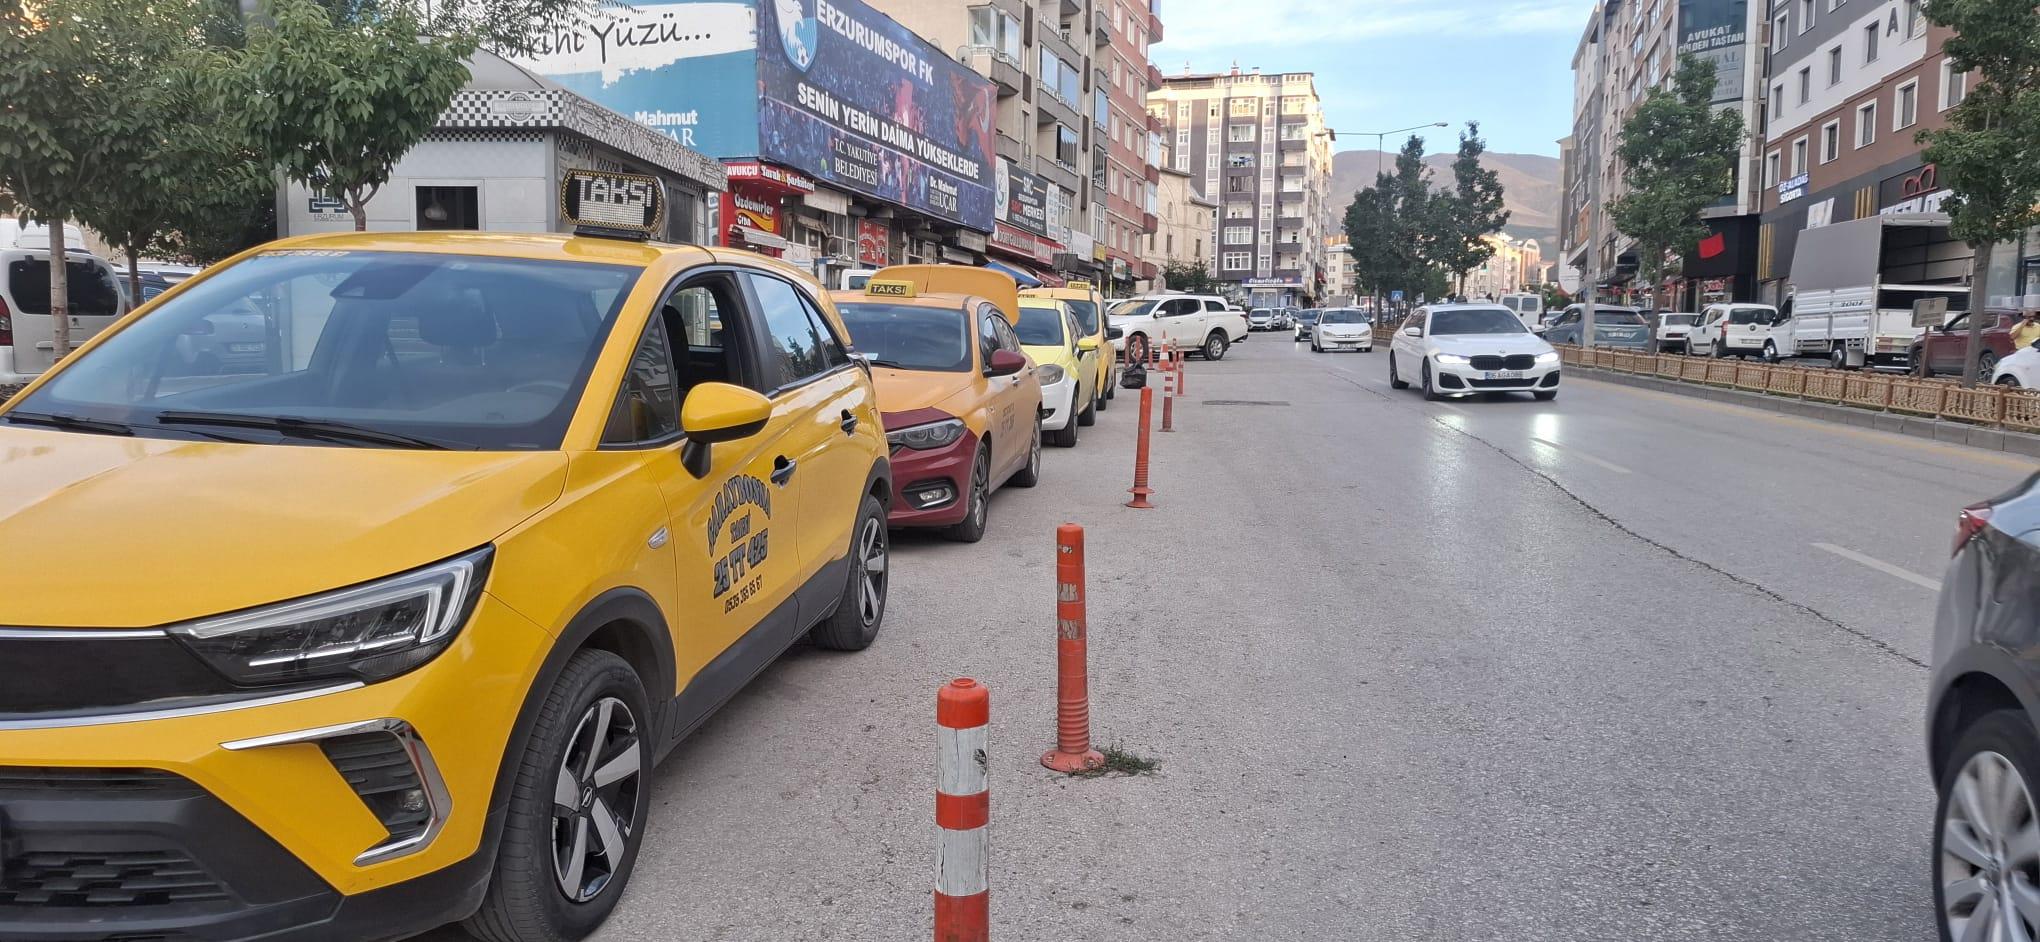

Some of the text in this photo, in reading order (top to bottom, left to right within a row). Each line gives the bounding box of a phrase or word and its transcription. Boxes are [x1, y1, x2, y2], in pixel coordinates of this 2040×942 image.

[816, 0, 934, 86] ERZURUMSPOR FK
[1687, 24, 1731, 42] AVUKAT
[634, 110, 698, 126] Mahmut
[798, 82, 979, 180] SENİN YERİN DAİMA YÜKSEKLERDE
[847, 142, 878, 166] YAKUTİYE
[834, 158, 878, 186] BELEDİYESİ
[713, 527, 769, 599] 25 TT 425
